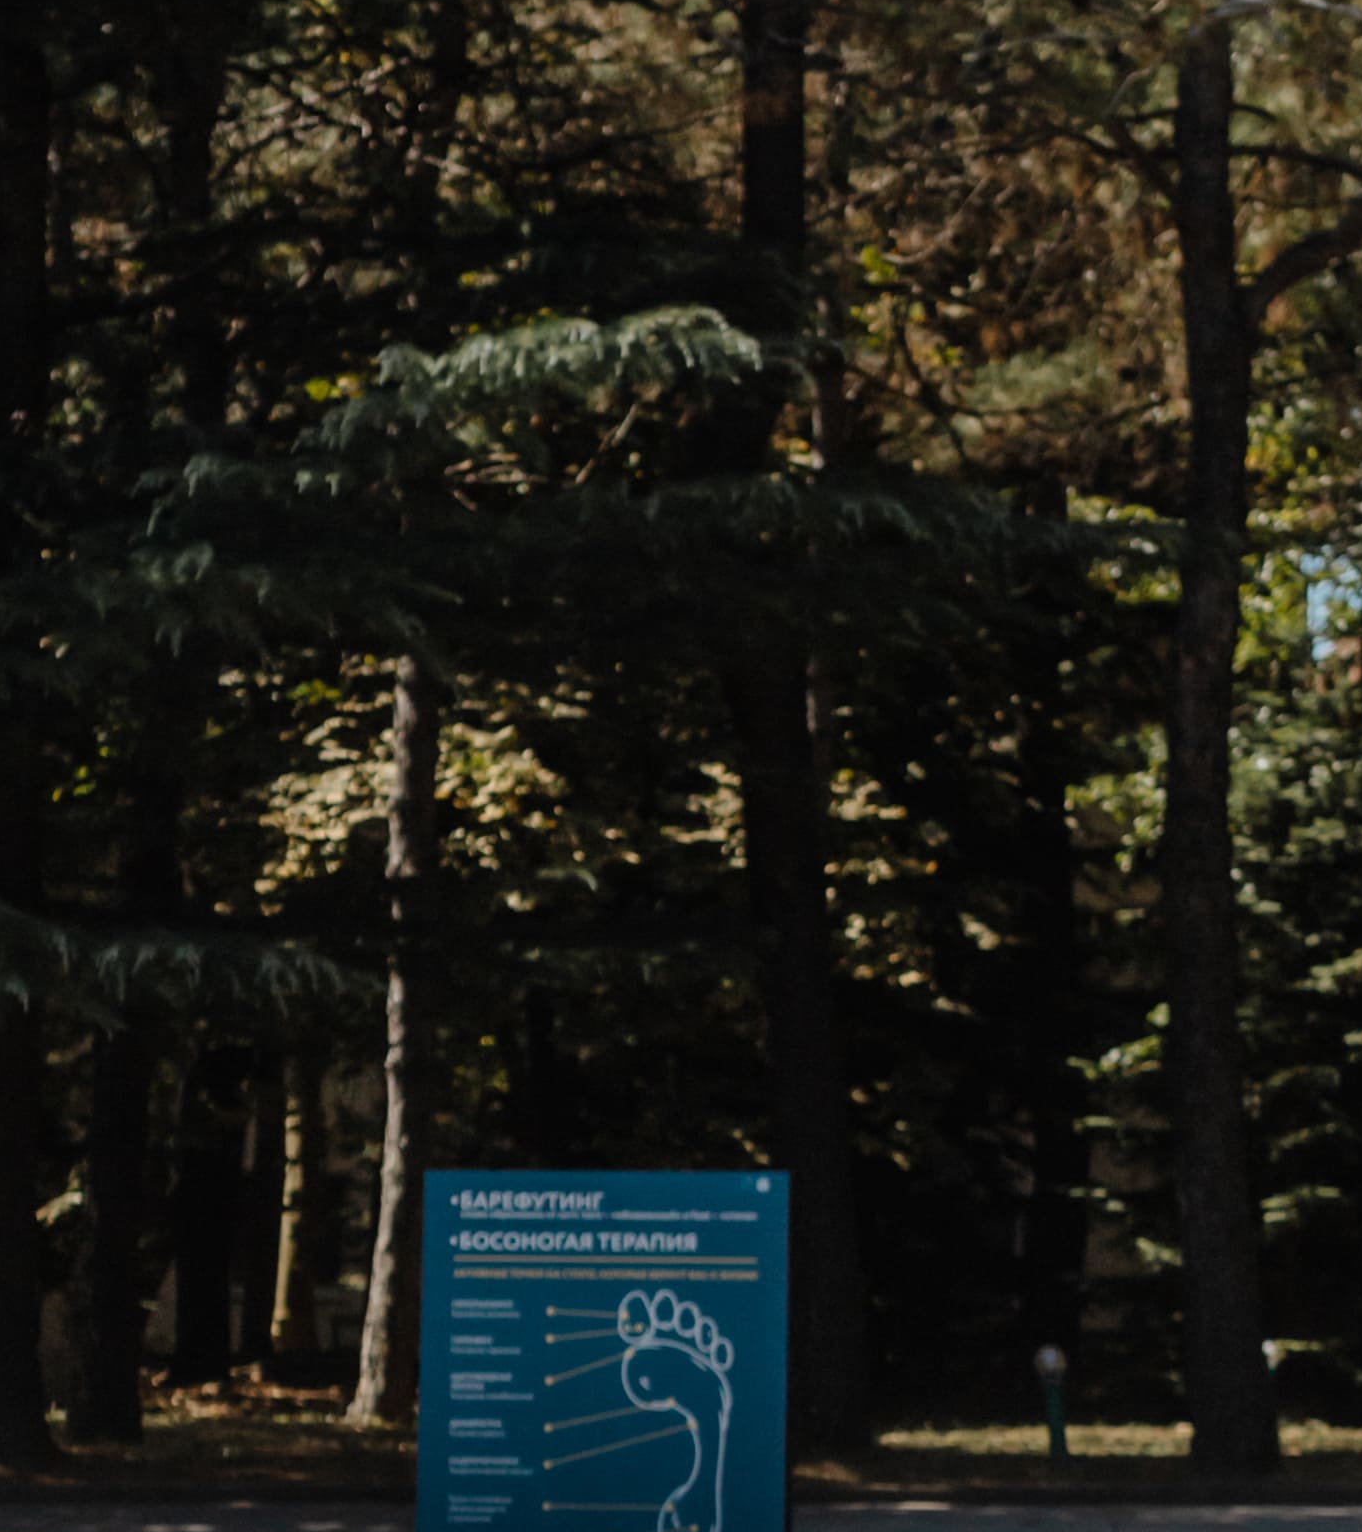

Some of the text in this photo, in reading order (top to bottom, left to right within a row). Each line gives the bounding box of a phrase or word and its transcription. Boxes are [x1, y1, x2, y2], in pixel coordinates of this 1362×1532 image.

[460, 1189, 605, 1211] БАРЕФУТИНГ
[459, 1229, 698, 1253] БОСОНОГАЯ ТЕРАПИЯ
